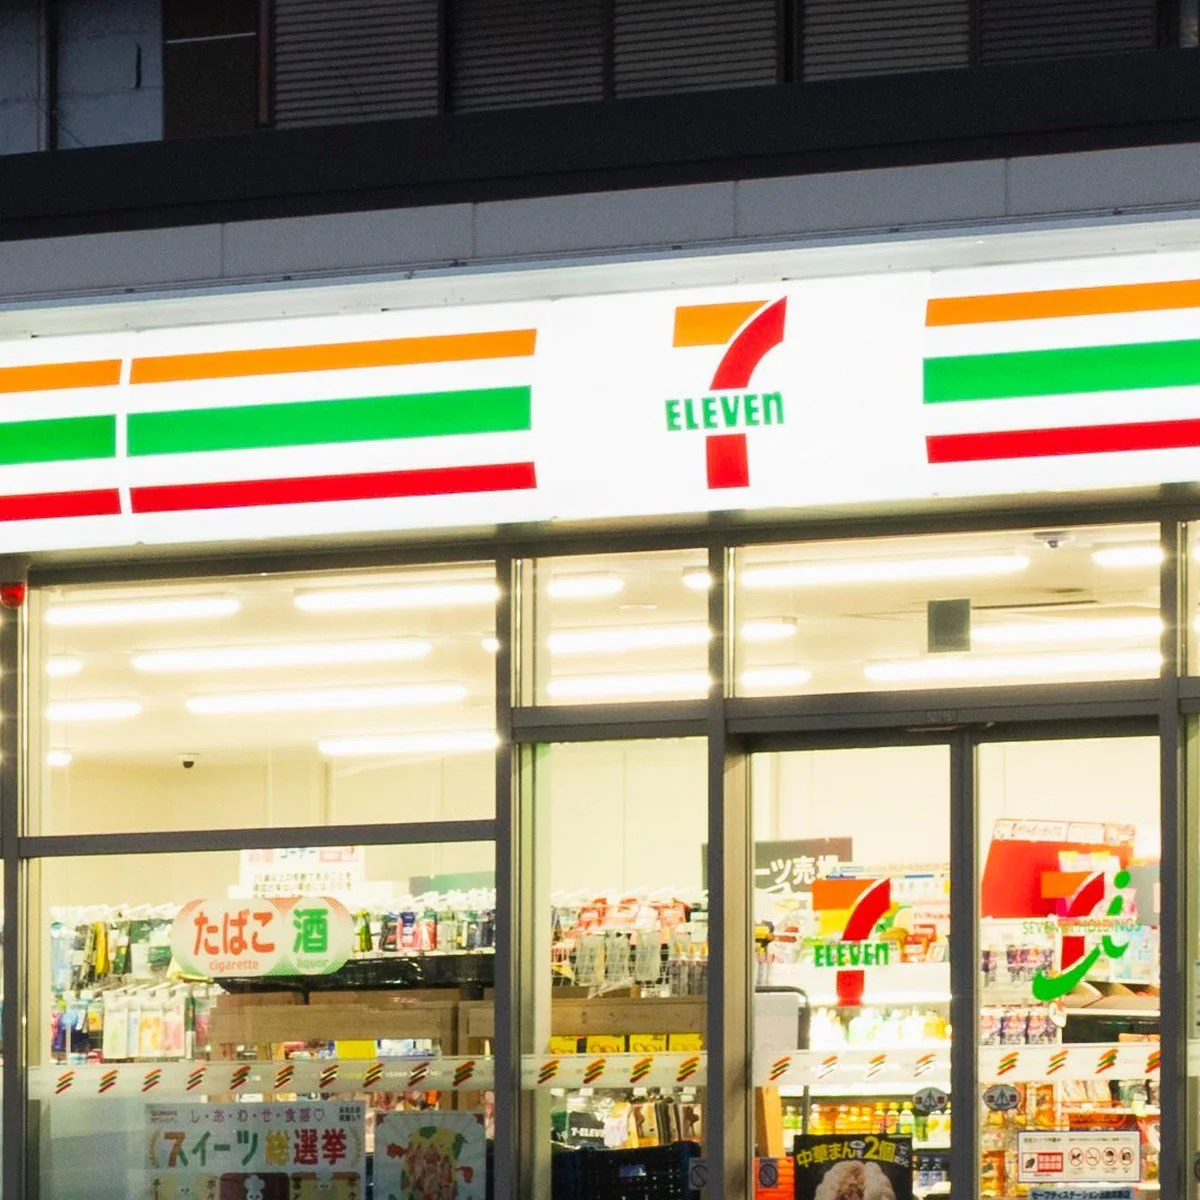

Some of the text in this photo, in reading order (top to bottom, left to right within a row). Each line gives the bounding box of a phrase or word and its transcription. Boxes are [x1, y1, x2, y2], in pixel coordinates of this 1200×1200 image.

[673, 296, 787, 489] 7
[193, 908, 275, 956] たばこ
[293, 908, 329, 954] 酒
[812, 877, 890, 1006] 7
[209, 958, 260, 972] cigarette
[163, 1128, 347, 1168] スイーツ総選挙
